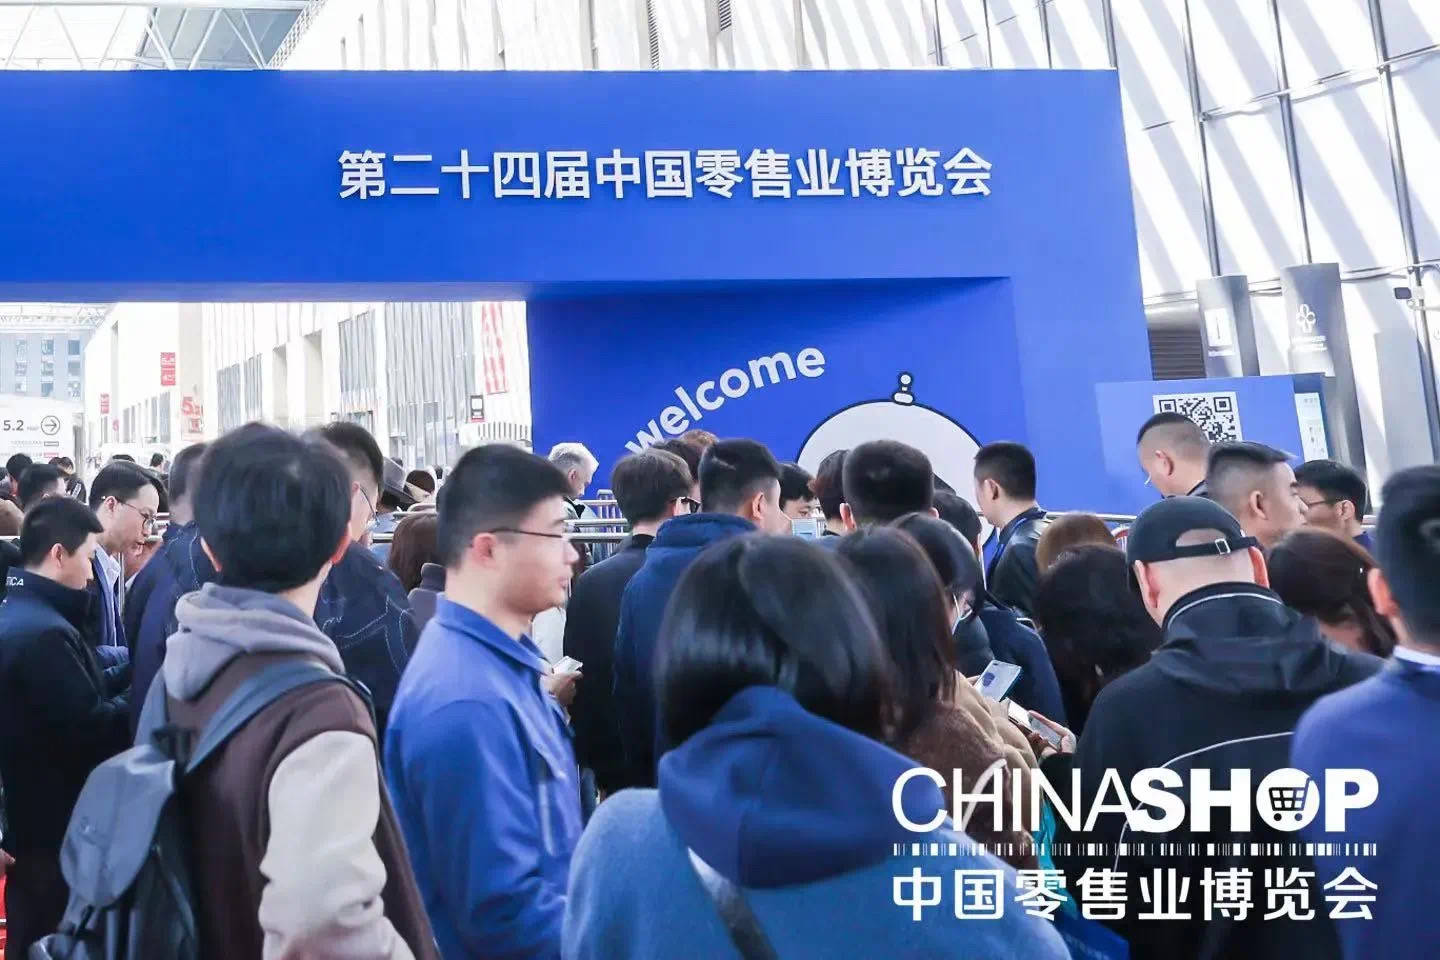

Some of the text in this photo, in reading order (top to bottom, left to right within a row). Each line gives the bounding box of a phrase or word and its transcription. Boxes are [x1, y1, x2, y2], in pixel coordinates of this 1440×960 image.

[338, 147, 993, 200] 第二十四届中国零售业博览会
[625, 347, 826, 445] welcome
[3, 419, 24, 431] 5.2
